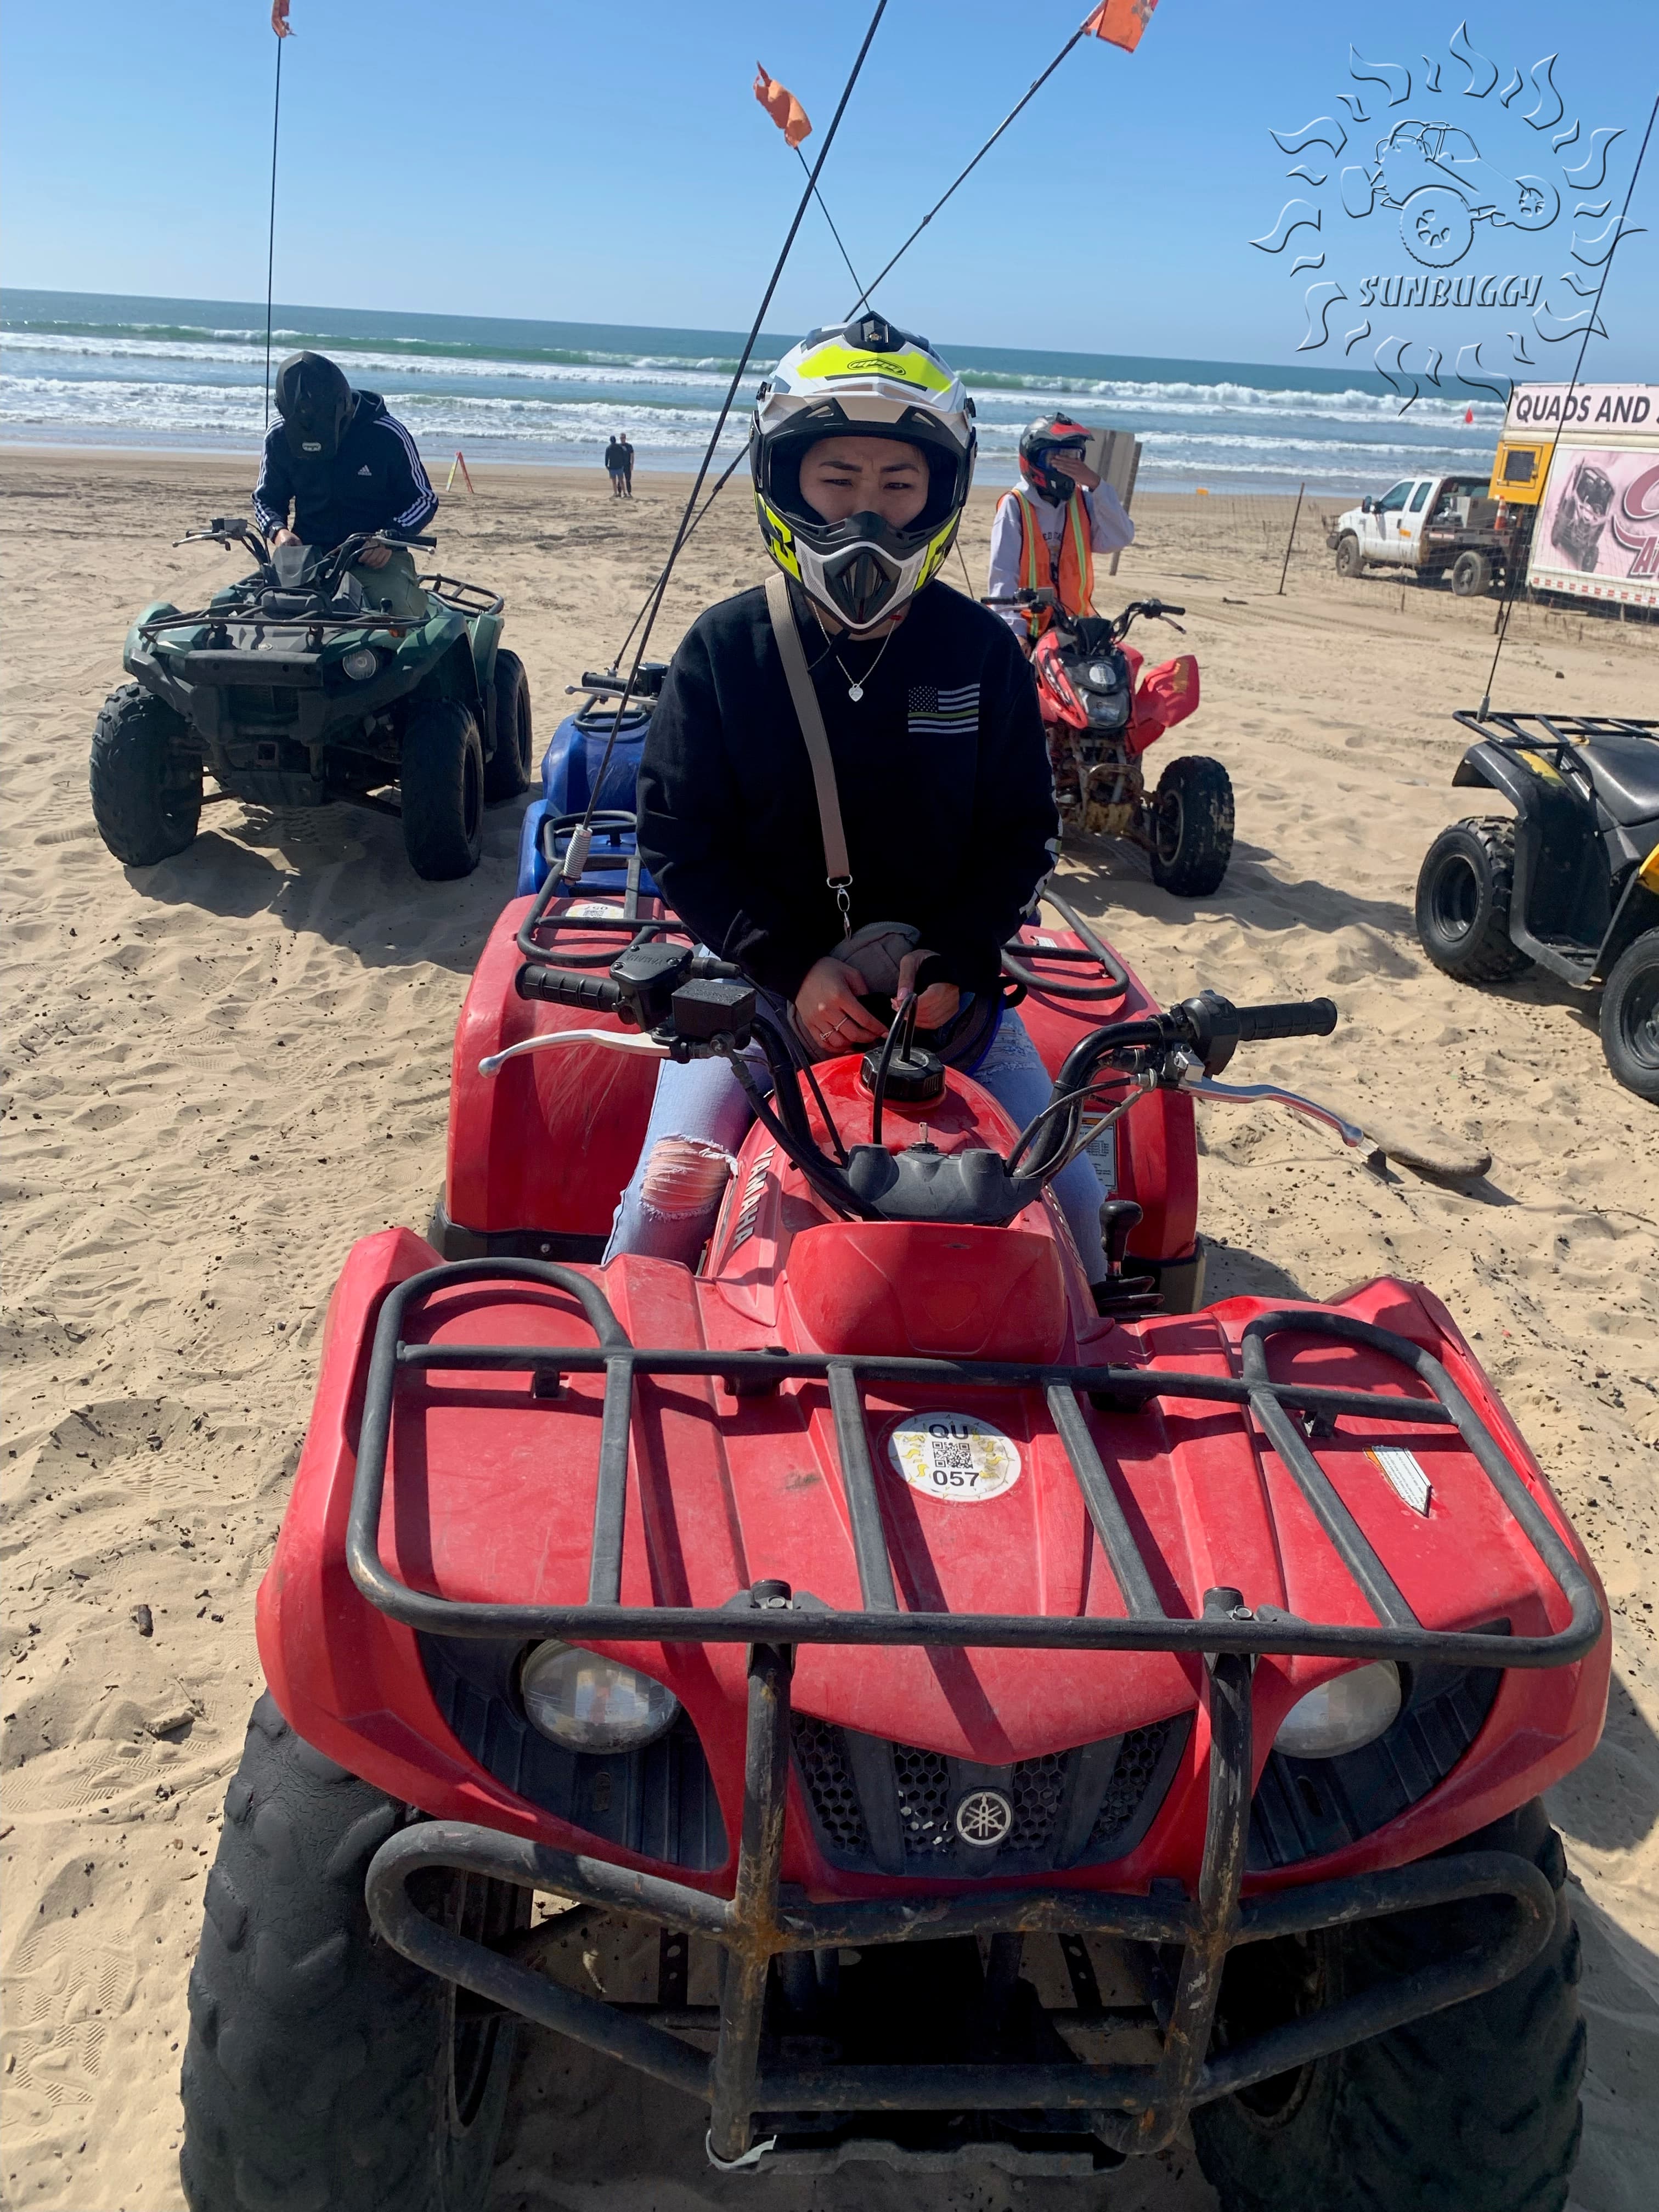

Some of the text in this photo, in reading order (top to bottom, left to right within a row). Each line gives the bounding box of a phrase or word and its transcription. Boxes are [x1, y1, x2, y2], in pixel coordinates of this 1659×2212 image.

[1516, 394, 1651, 423] QUADS AND
[732, 1143, 777, 1251] YAMAHA
[929, 1424, 969, 1440] QU
[933, 1470, 979, 1487] 057
